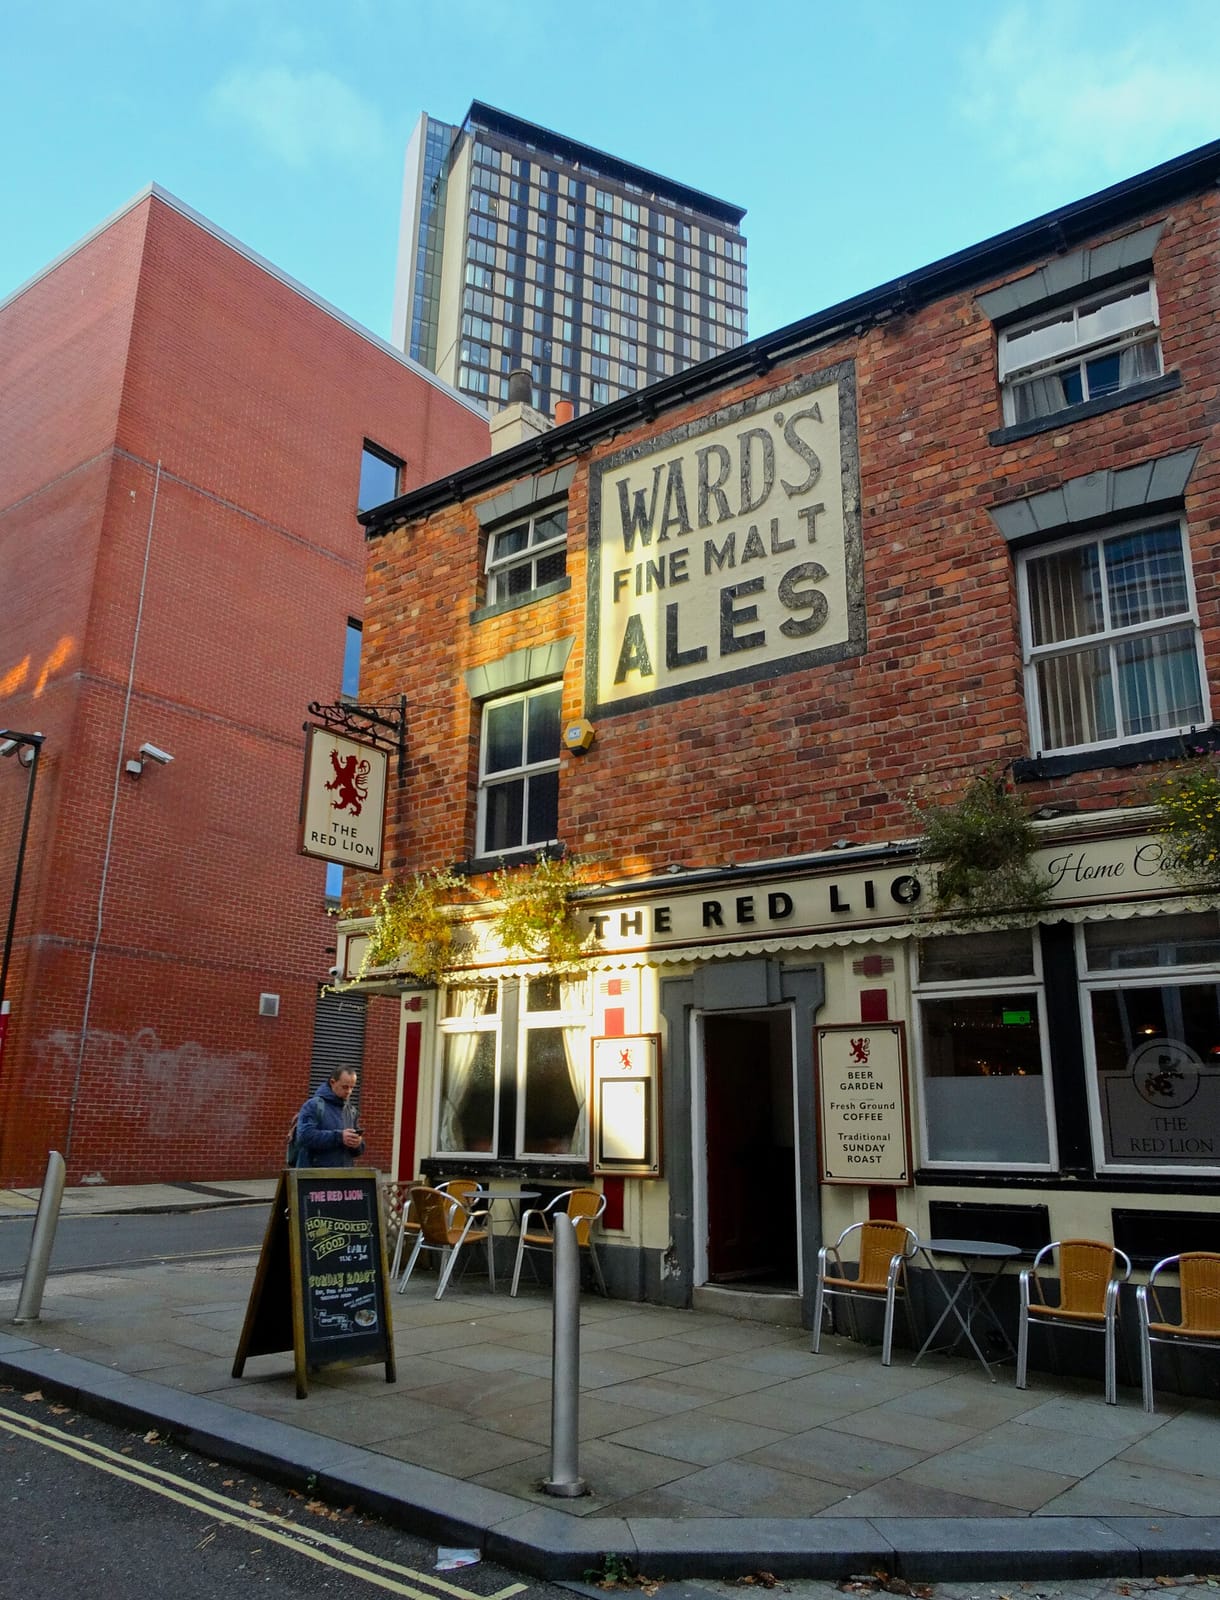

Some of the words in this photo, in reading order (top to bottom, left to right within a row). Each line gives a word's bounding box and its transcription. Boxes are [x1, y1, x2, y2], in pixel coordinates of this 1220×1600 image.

[615, 401, 824, 553] WARD'S
[613, 547, 690, 604] FINE
[703, 502, 826, 576] MALT
[613, 561, 830, 686] ALES
[332, 822, 358, 839] THE
[311, 831, 337, 847] RED
[343, 840, 374, 856] LION
[1047, 852, 1125, 889] Home
[588, 906, 673, 940] THE
[702, 891, 794, 928] RED
[830, 1101, 856, 1110] Fresh
[859, 1102, 895, 1110] Ground
[843, 1113, 883, 1121] COFFEE
[1151, 1117, 1189, 1132] THE
[838, 1133, 890, 1141] Traditional
[1130, 1137, 1165, 1153] RED
[1168, 1137, 1214, 1153] LION
[842, 1144, 885, 1152] SUNDAY
[847, 1155, 882, 1164] ROAST
[309, 1191, 326, 1202] THE
[326, 1190, 343, 1201] RED
[343, 1189, 364, 1201] LION
[333, 1222, 368, 1232] COOKED
[319, 1237, 346, 1255] FOOD
